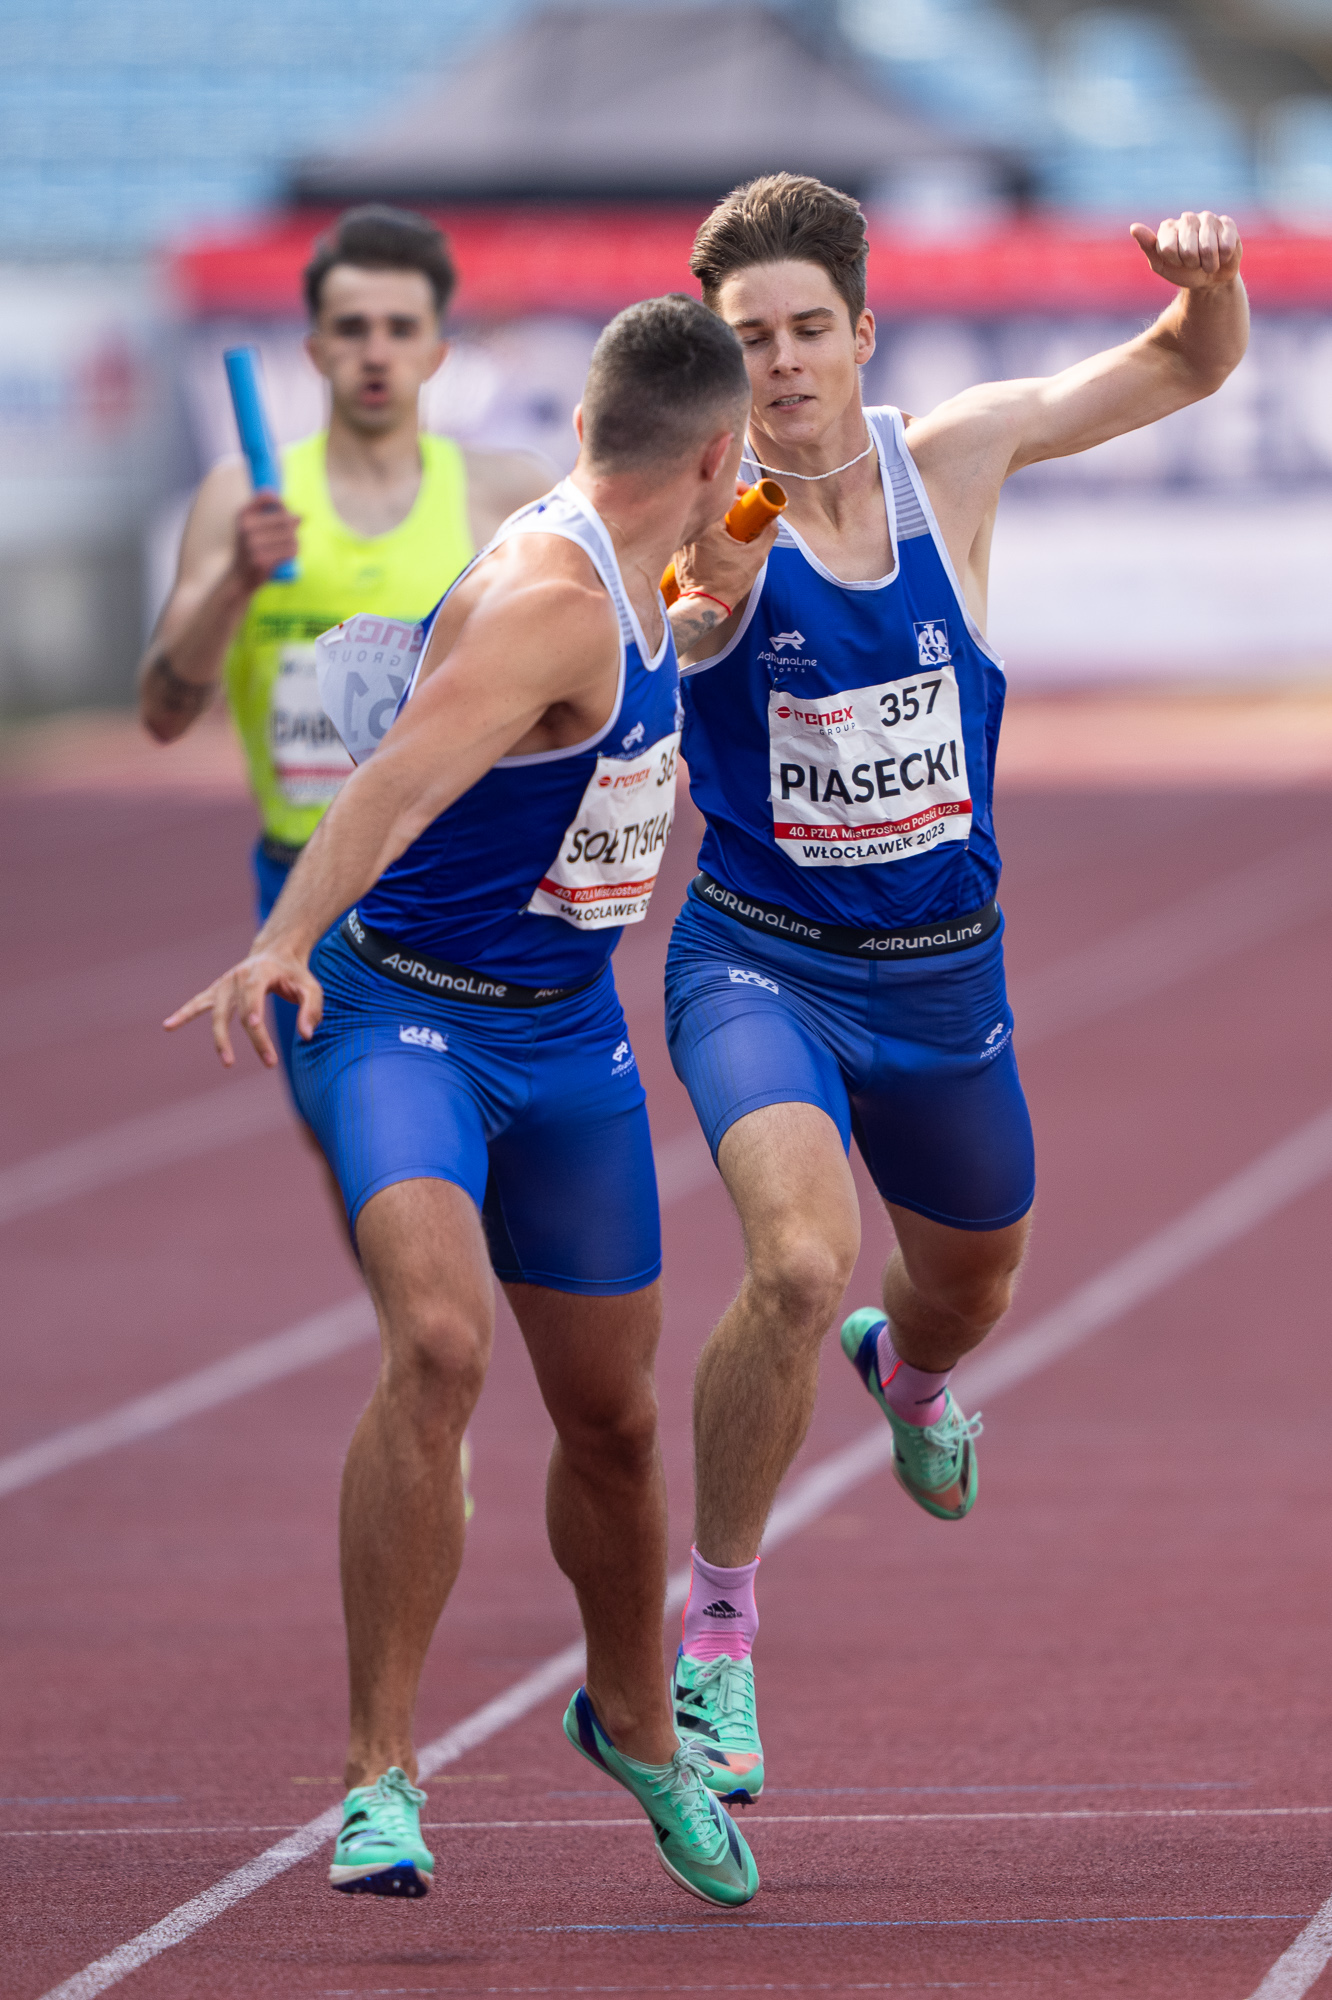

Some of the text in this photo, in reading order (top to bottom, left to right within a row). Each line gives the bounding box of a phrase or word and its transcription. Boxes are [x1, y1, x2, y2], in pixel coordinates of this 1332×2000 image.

[757, 651, 817, 667] AdRunaLine
[879, 678, 942, 727] 357
[819, 722, 856, 736] GROUP
[656, 746, 677, 787] 36
[780, 739, 960, 805] PIASECKI
[788, 826, 808, 838] 40.
[810, 828, 839, 839] PZLA
[912, 809, 937, 828] Polski
[938, 804, 960, 816] U23
[802, 822, 945, 859] WŁOCŁAWEK 2023
[560, 902, 638, 922] WŁOCŁAWEK
[704, 882, 822, 940] AdRunaLine
[858, 922, 983, 951] AdRunaLine
[382, 953, 508, 998] AdRunaLine
